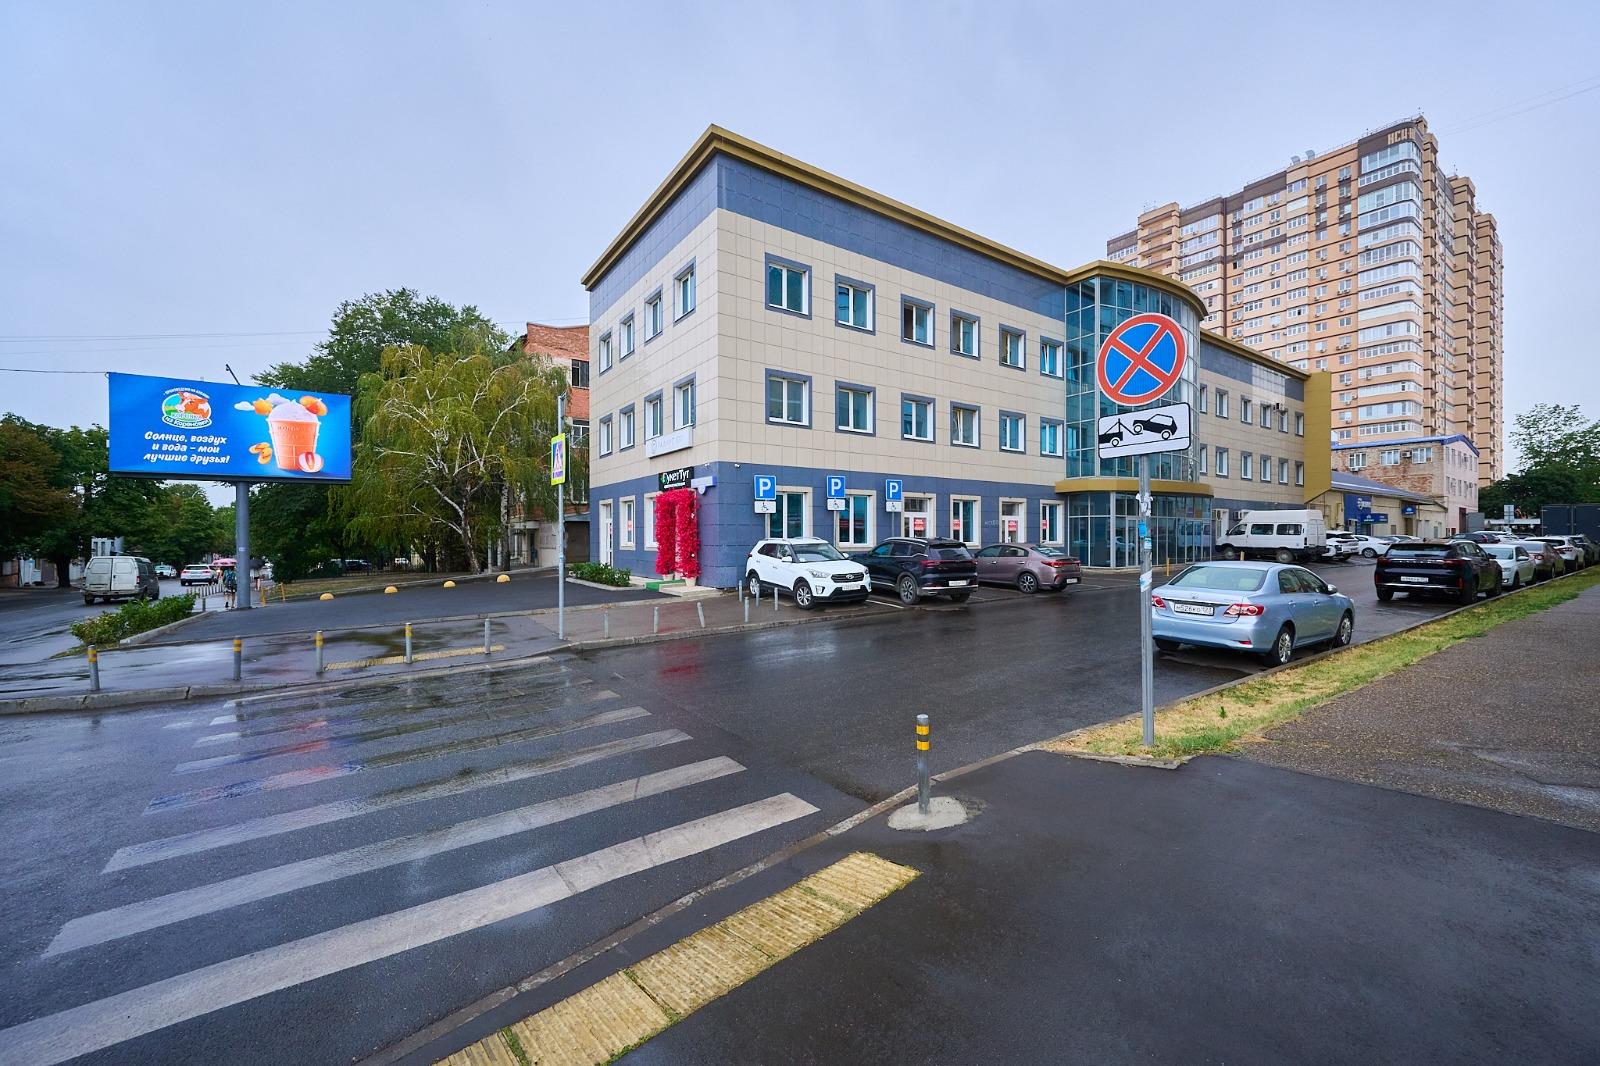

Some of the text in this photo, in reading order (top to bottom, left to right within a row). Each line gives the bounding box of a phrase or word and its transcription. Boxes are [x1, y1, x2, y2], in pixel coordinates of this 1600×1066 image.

[144, 431, 227, 445] Солнце, воздух
[151, 443, 160, 451] и
[162, 443, 188, 452] вода
[198, 445, 220, 453] мои
[143, 453, 230, 465] лучшие друзья!
[759, 478, 772, 497] P
[831, 478, 842, 496] P
[889, 482, 899, 498] P
